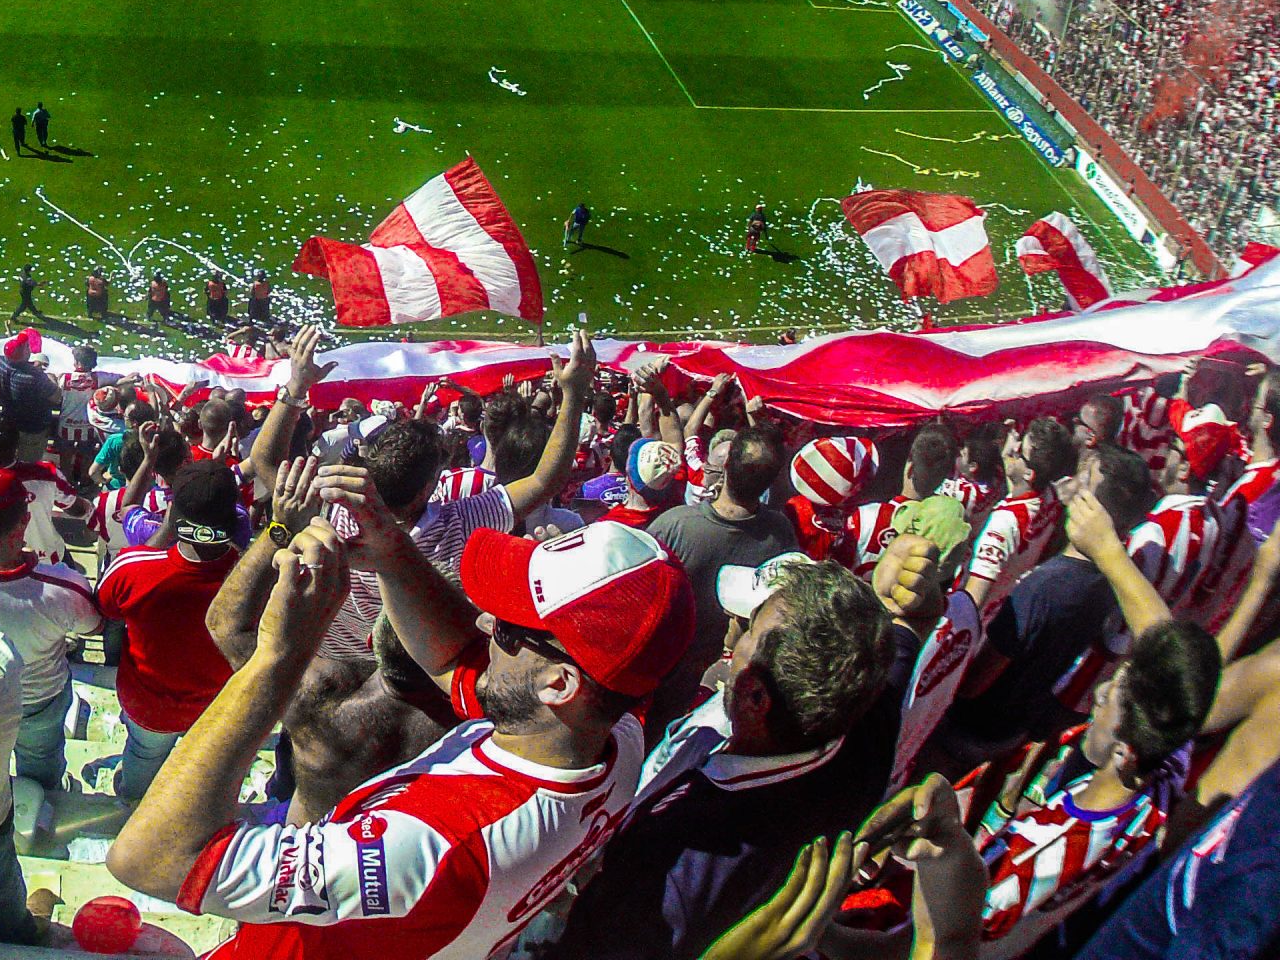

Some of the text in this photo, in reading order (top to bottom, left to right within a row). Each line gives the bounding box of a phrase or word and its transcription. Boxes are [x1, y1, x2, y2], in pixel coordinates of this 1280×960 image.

[944, 41, 964, 58] LED
[974, 71, 1063, 167] Allianz Seguros
[533, 580, 545, 603] TBS
[275, 845, 299, 905] Vidalac
[362, 816, 385, 910] Red Mutual
